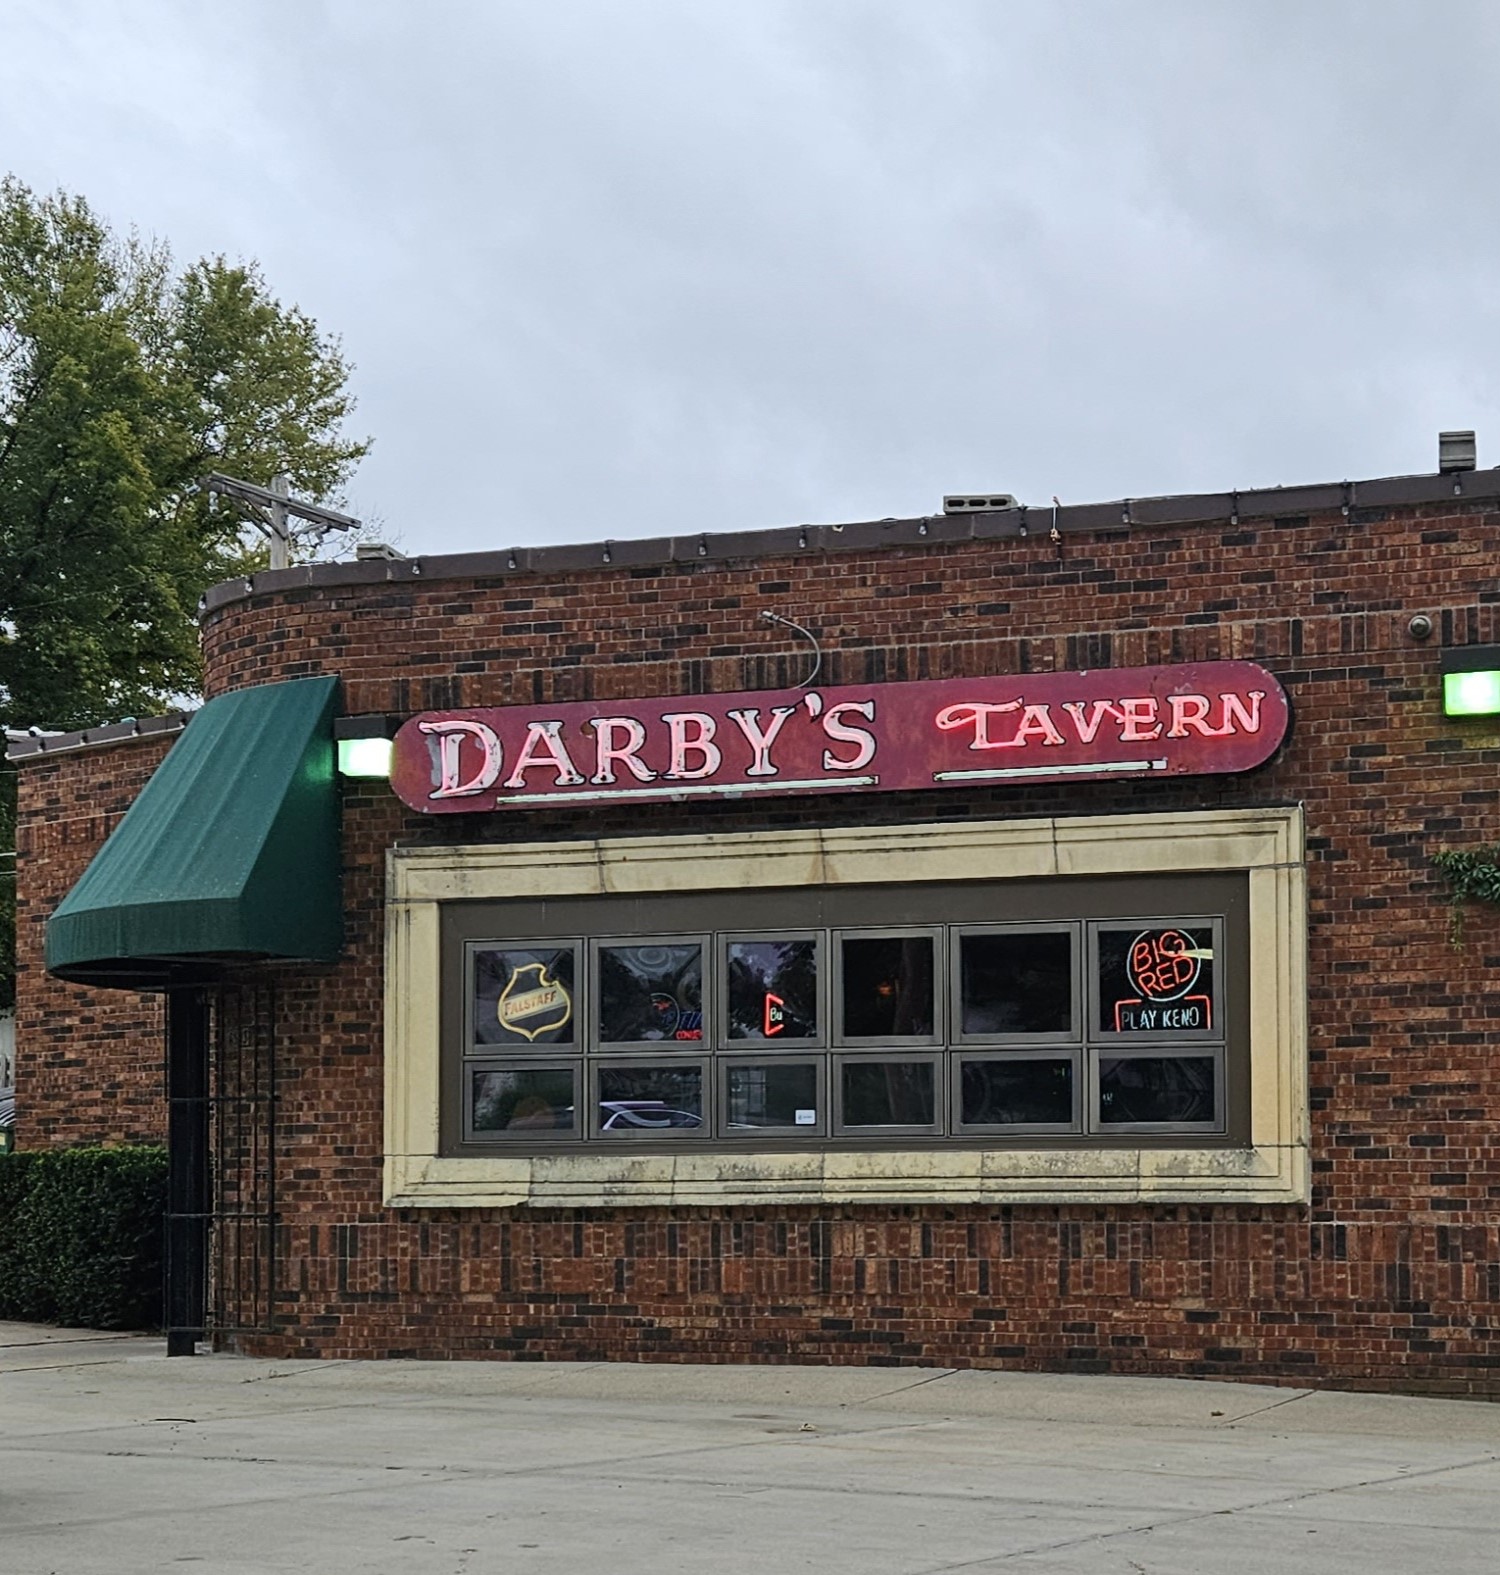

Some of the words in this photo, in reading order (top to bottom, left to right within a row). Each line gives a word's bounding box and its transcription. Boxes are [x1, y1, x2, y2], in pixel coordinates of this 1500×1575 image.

[418, 692, 876, 799] DARBY'S
[934, 690, 1267, 750] TAVERN
[1133, 931, 1186, 972] BIG
[1138, 956, 1194, 997] RED
[504, 990, 557, 1016] FALSTAFF
[1121, 1009, 1157, 1029] PLAY
[1162, 1006, 1200, 1027] KENO
